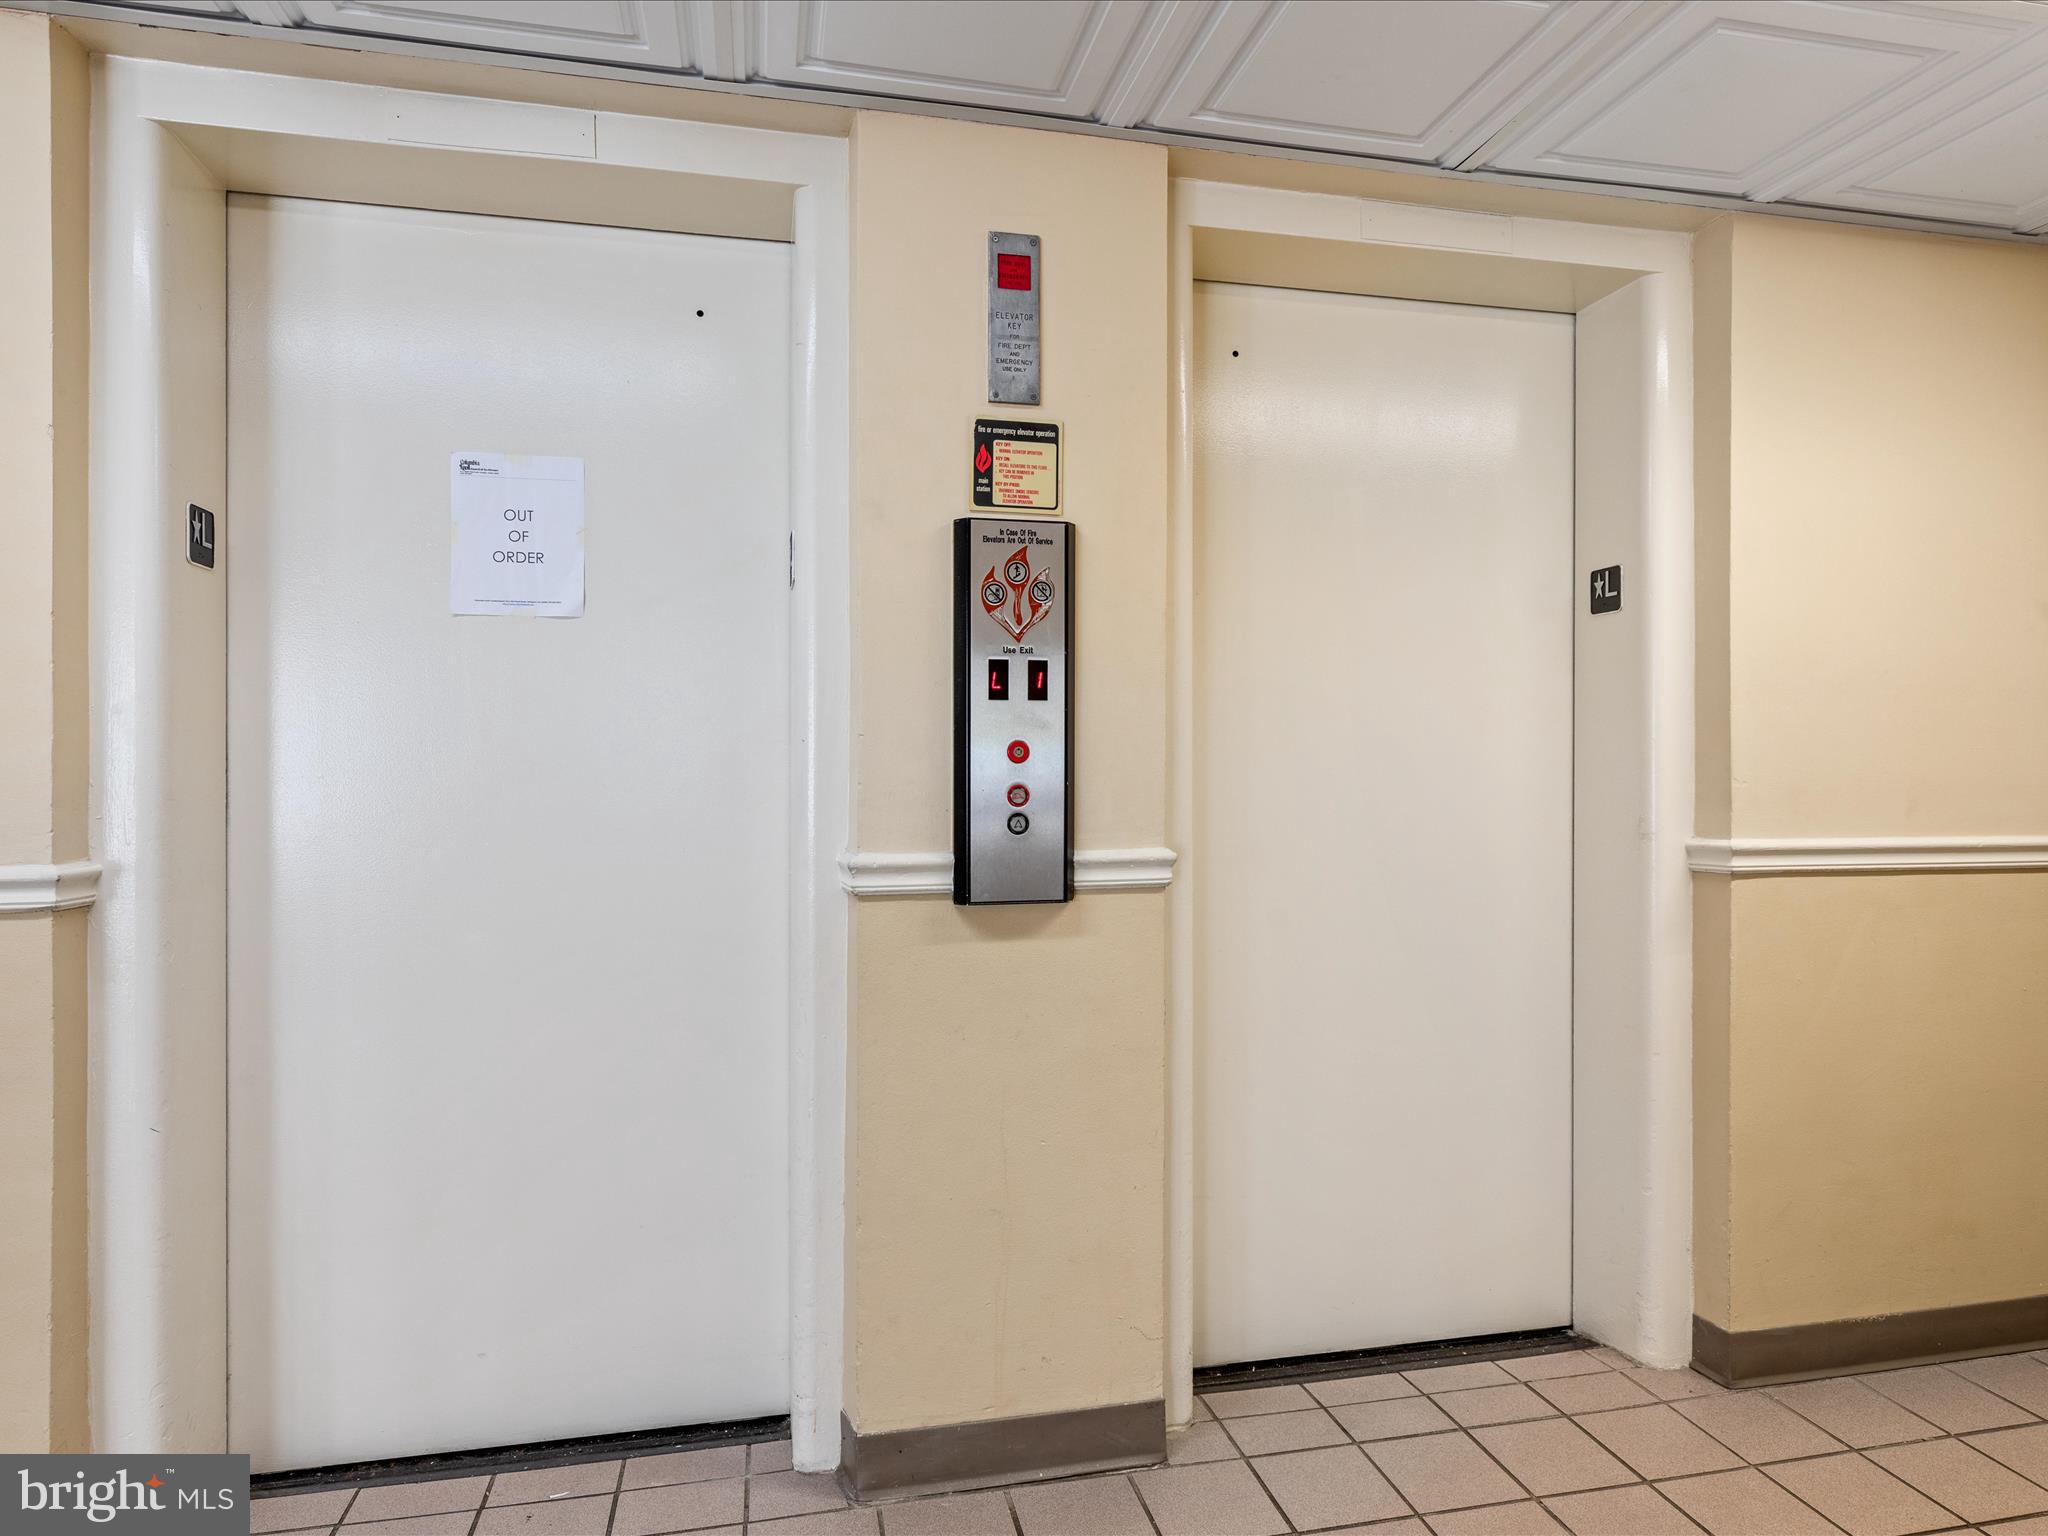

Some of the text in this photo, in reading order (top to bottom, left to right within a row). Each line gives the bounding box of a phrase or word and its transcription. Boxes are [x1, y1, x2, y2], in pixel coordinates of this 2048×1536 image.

[995, 311, 1034, 321] ELEVATOR
[1007, 322, 1022, 330] KEY
[995, 357, 1033, 366] EMERGENCY
[977, 425, 986, 433] fire
[992, 427, 1016, 436] emergency
[1017, 428, 1035, 436] elevator
[1035, 430, 1056, 438] operation
[503, 508, 534, 522] OUT
[202, 512, 213, 550] L
[508, 530, 529, 543] OF
[999, 528, 1037, 537] In Case Of Fire
[982, 535, 1054, 546] Elevators Are Out Of Service
[492, 550, 544, 564] ORDER
[1605, 570, 1618, 598] L
[1002, 646, 1034, 655] Use Exit
[991, 671, 1002, 689] L
